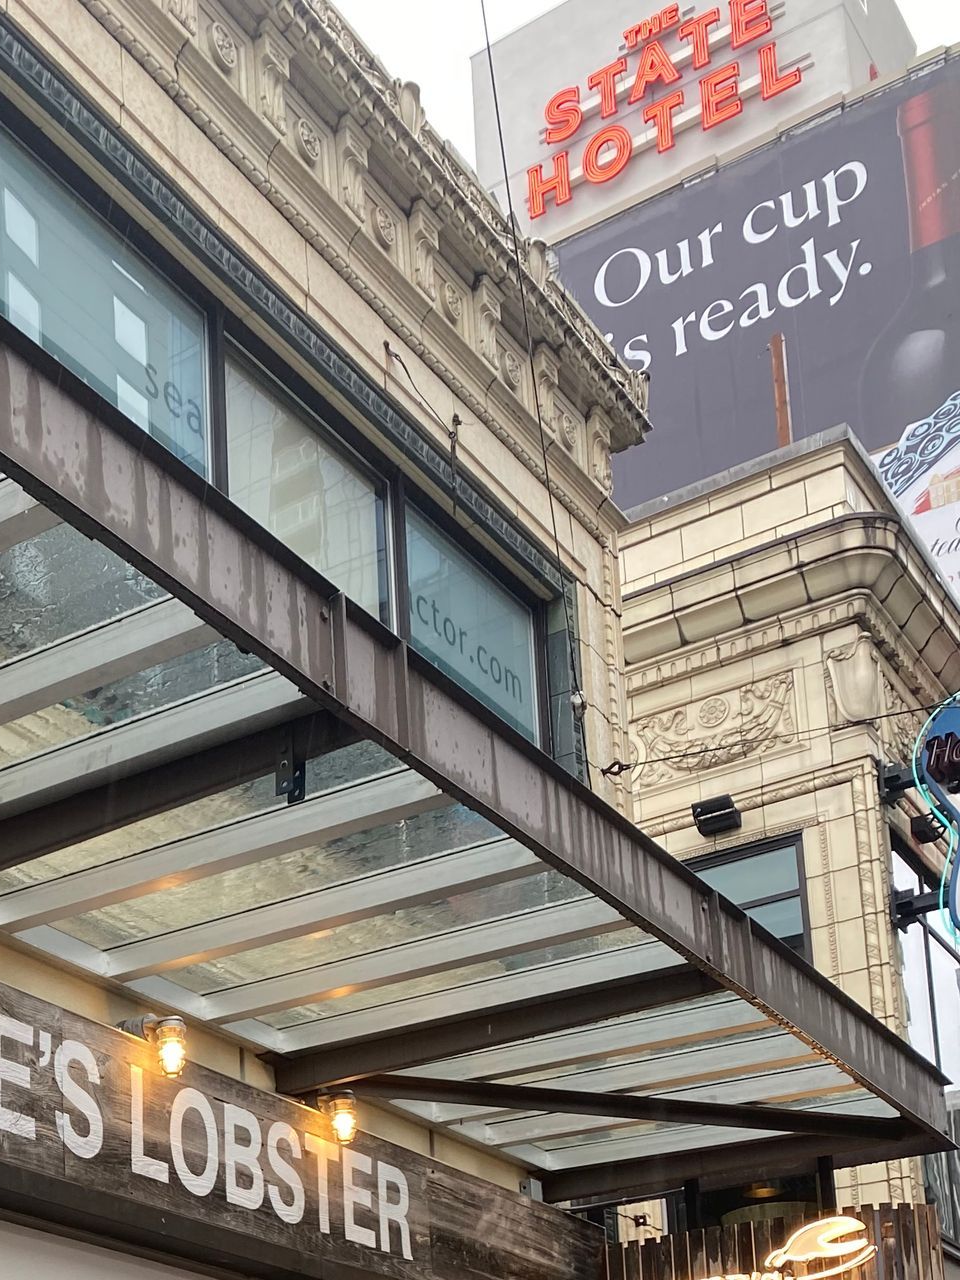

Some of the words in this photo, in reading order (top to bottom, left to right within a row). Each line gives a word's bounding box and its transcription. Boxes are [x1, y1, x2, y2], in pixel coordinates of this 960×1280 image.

[544, 0, 777, 145] STATE
[623, 3, 680, 50] THE
[527, 41, 802, 220] HOTEL
[593, 221, 723, 308] Our
[740, 160, 868, 245] cup
[671, 237, 873, 358] ready.
[144, 362, 204, 441] sea
[409, 588, 523, 704] ctor.com
[130, 1064, 413, 1261] LOBSTER
